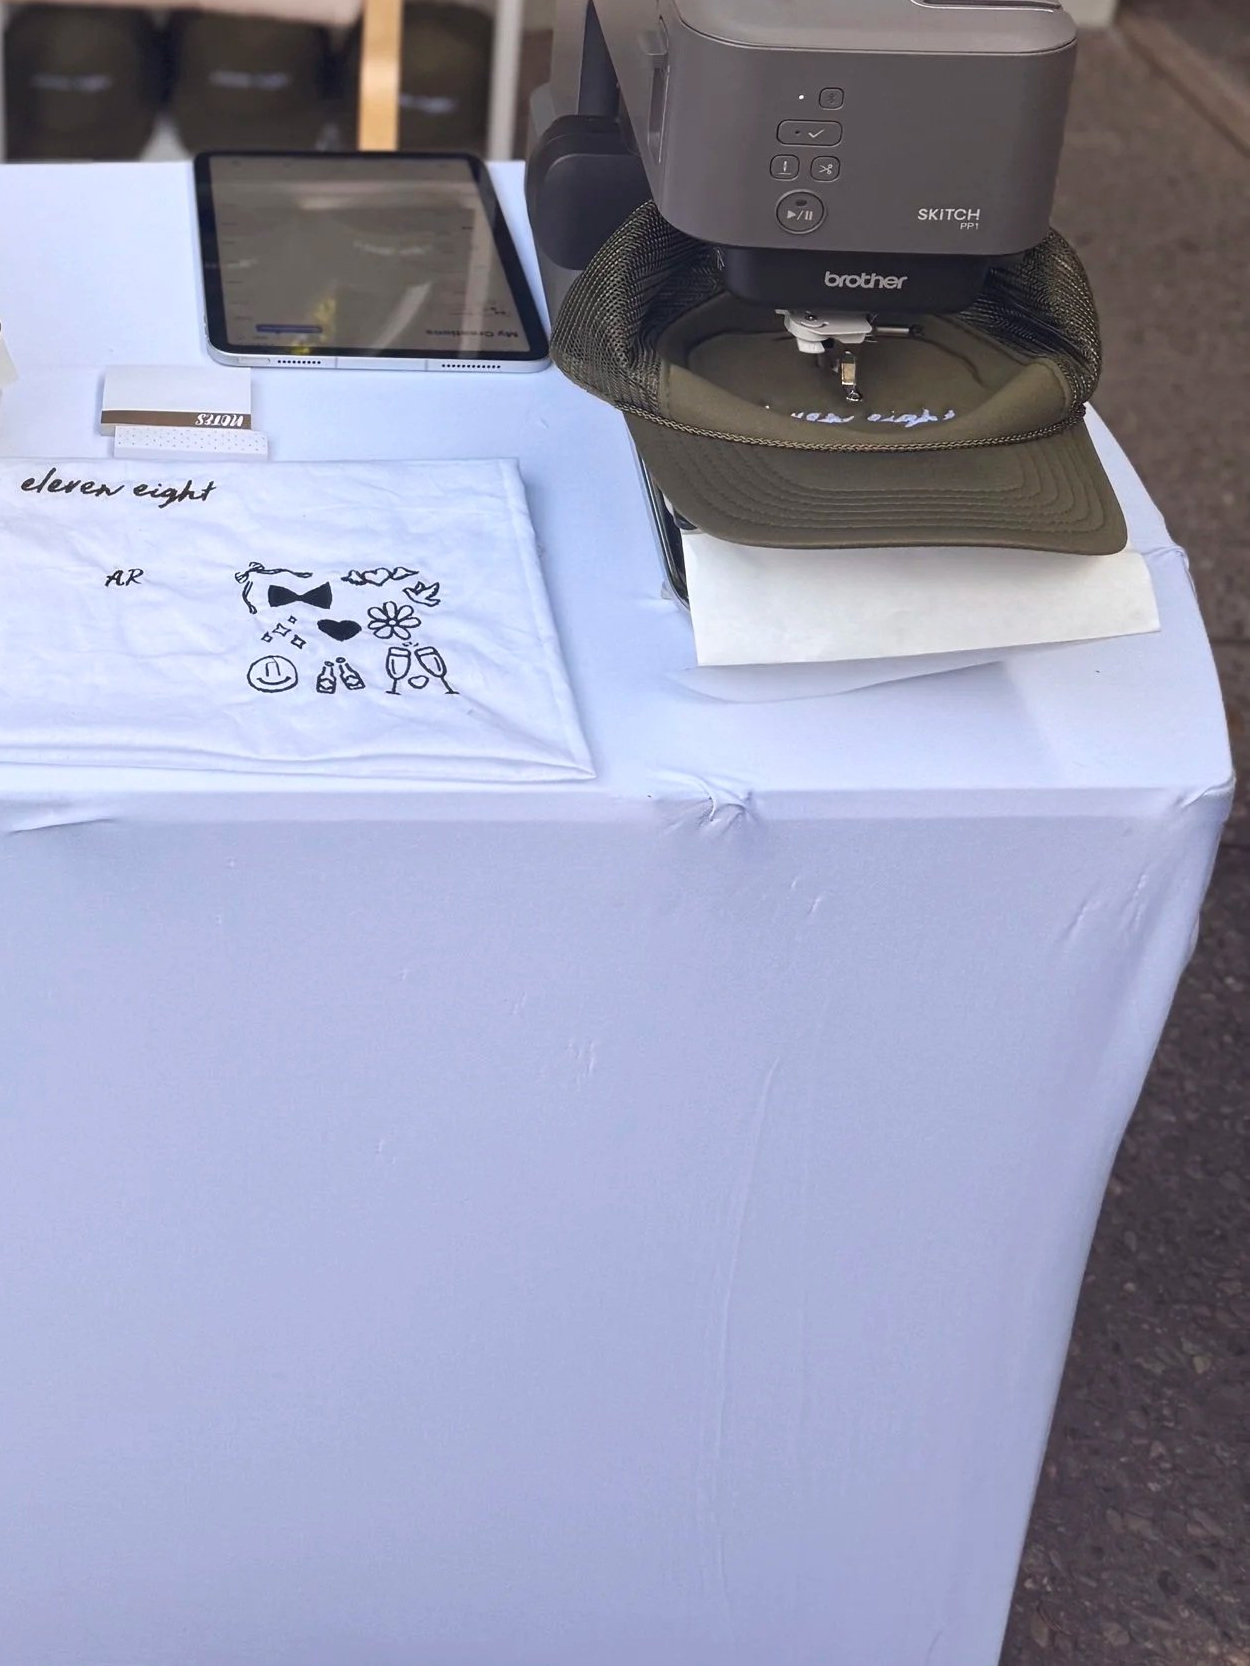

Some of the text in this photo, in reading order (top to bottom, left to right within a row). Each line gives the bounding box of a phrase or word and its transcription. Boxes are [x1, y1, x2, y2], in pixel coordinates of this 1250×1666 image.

[959, 222, 979, 230] PP1
[824, 270, 908, 289] brother
[195, 413, 243, 427] NOTES
[21, 467, 216, 509] eleven eight
[104, 568, 144, 588] AR
